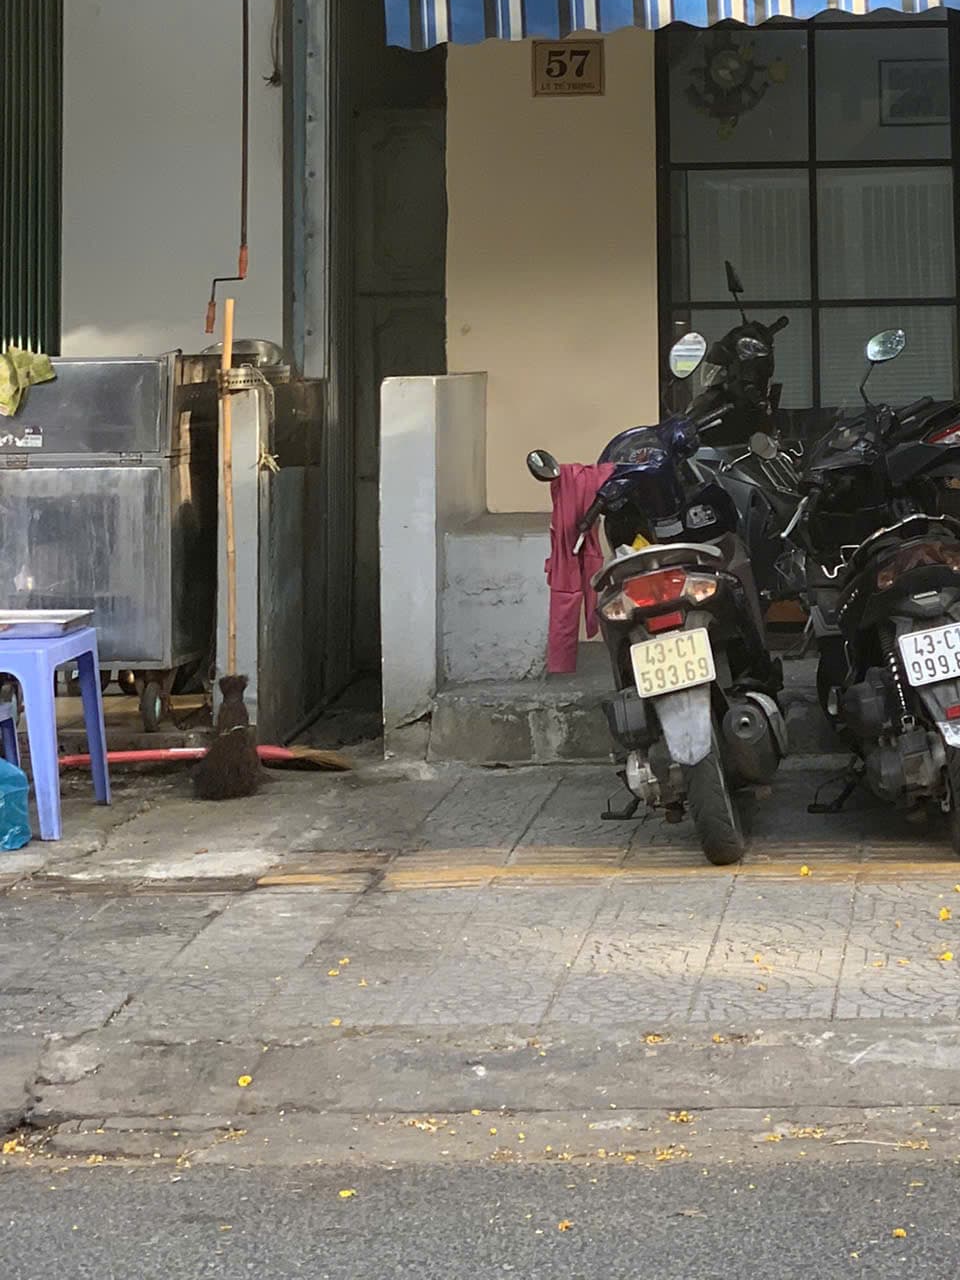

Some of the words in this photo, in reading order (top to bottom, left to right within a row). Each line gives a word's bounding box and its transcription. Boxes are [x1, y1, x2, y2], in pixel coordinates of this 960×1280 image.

[546, 49, 590, 78] 57
[645, 635, 696, 665] 43-C1
[641, 657, 710, 693] 593.69
